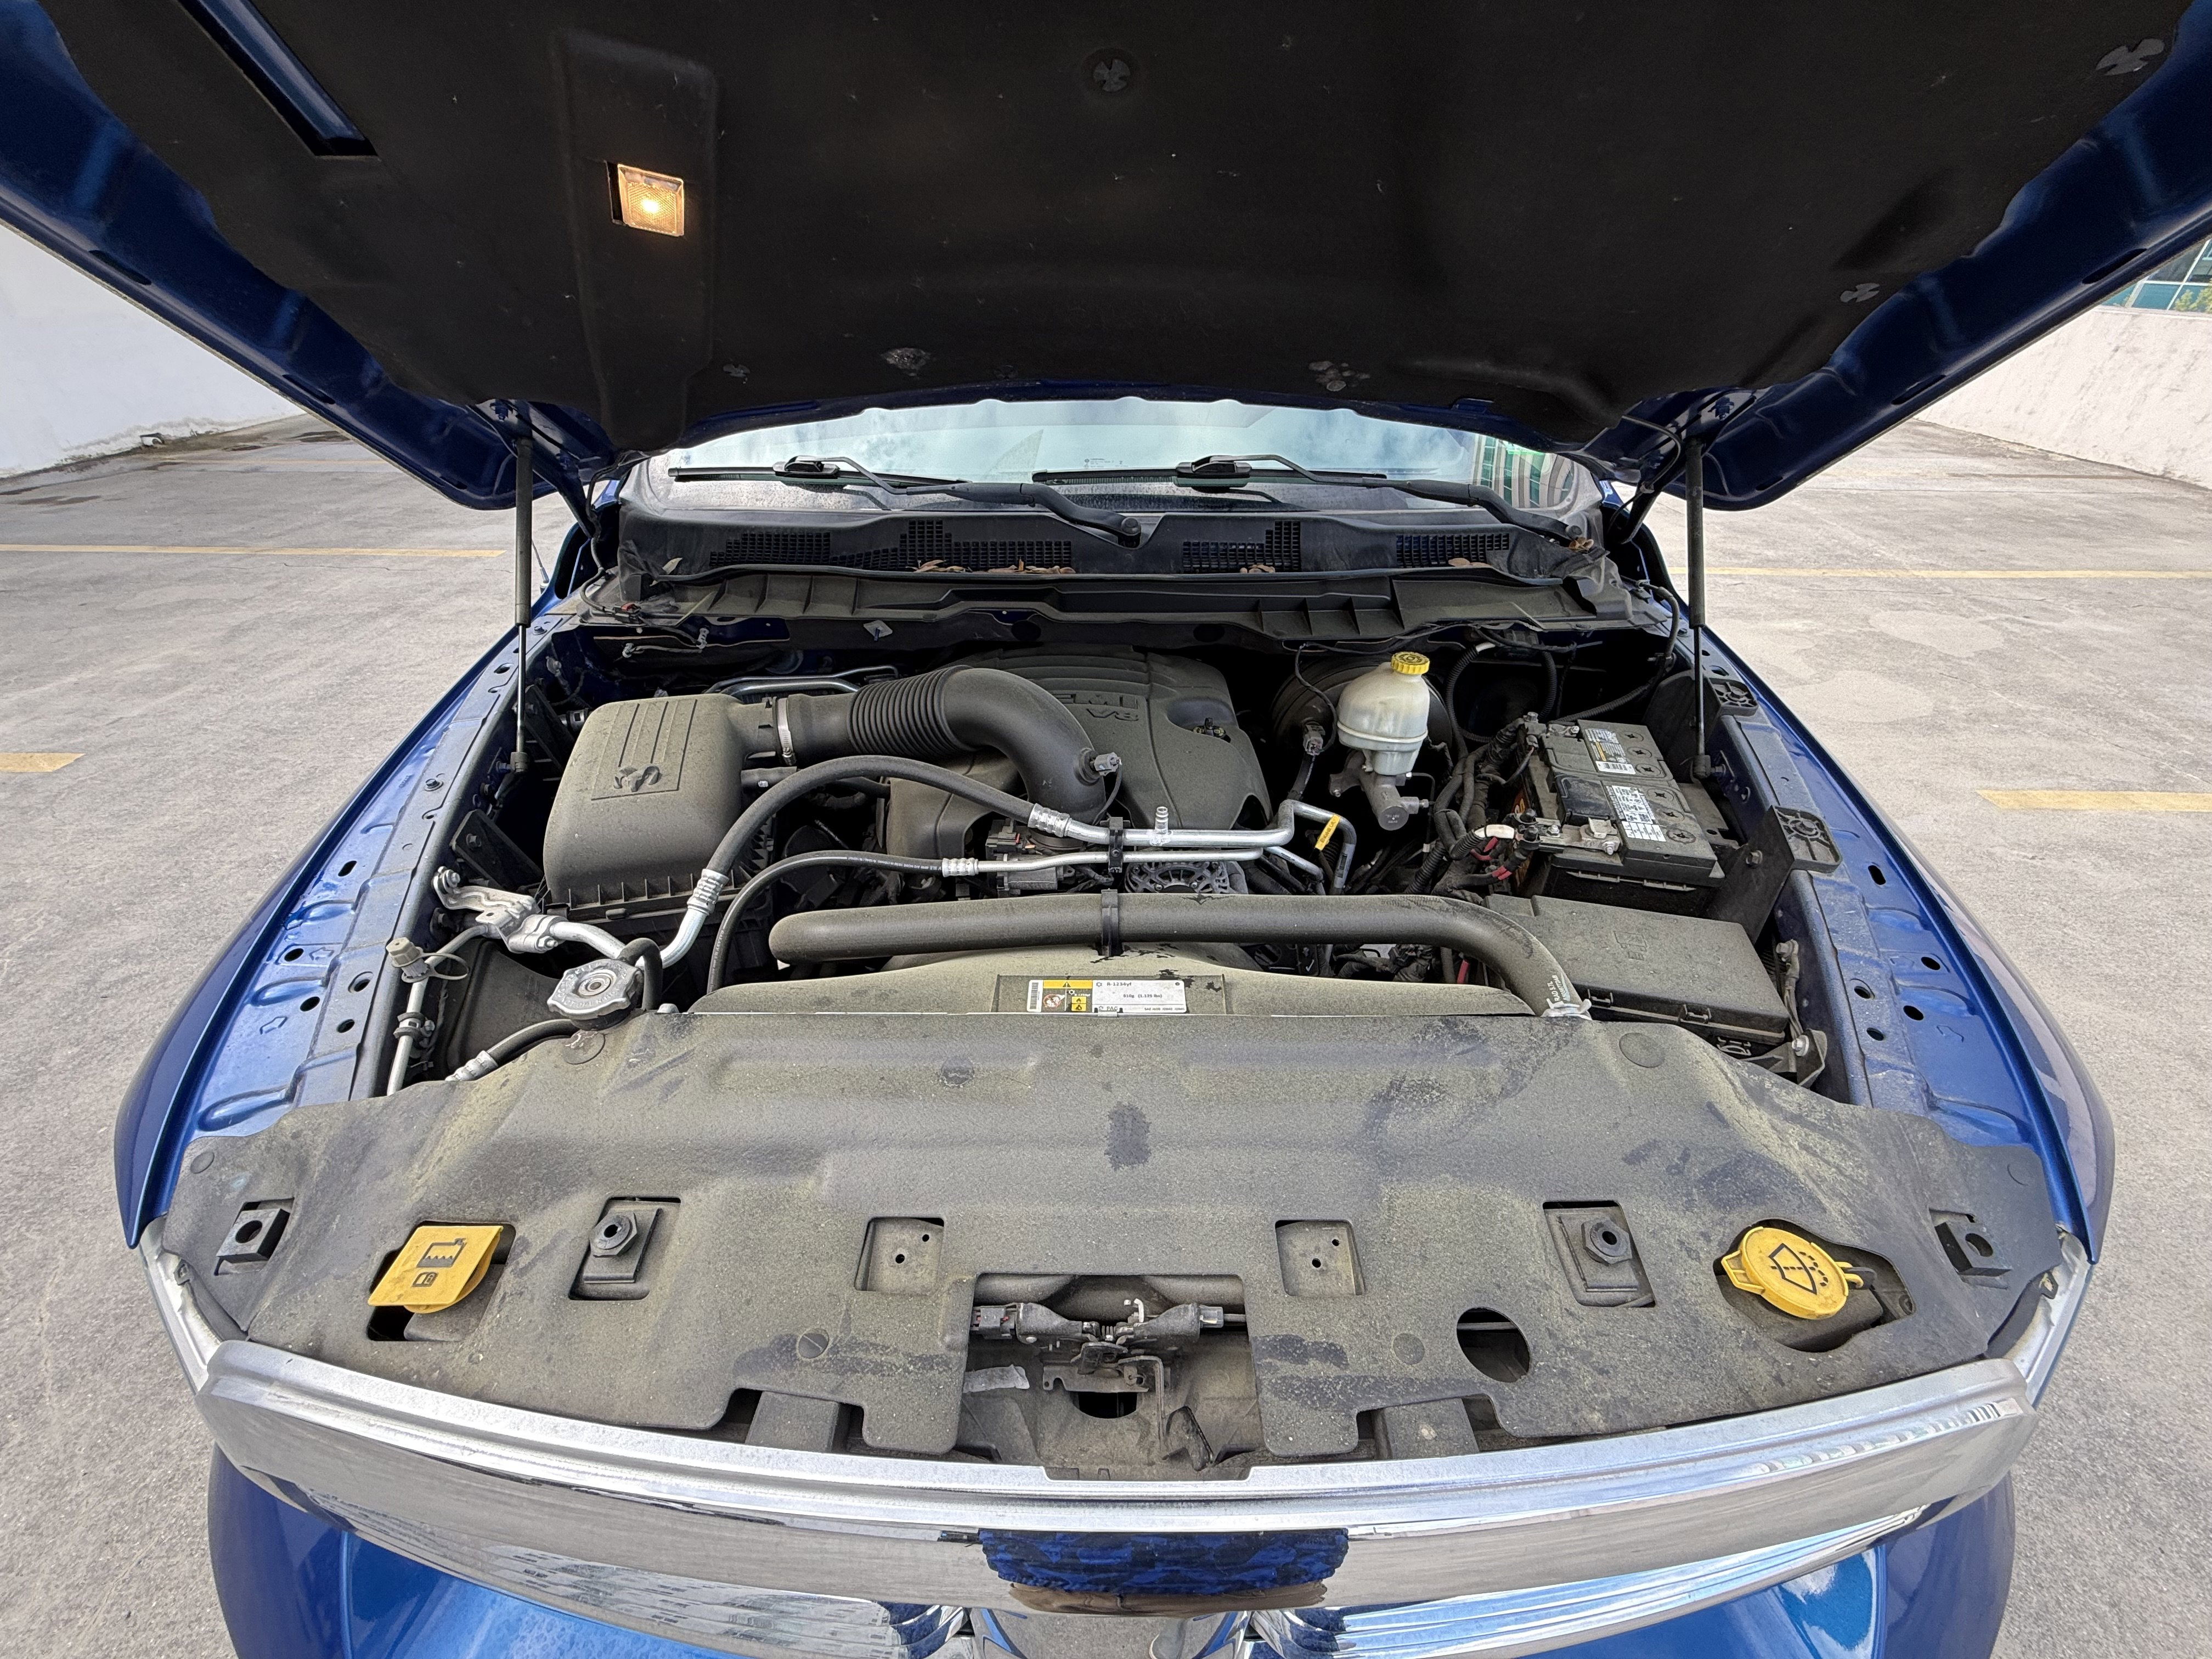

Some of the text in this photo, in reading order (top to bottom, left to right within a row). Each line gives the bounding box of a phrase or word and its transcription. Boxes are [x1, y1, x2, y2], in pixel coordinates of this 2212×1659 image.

[1052, 693, 1138, 709] EMI
[1086, 708, 1139, 722] V8
[1547, 980, 1561, 1001] RAD 5.7L
